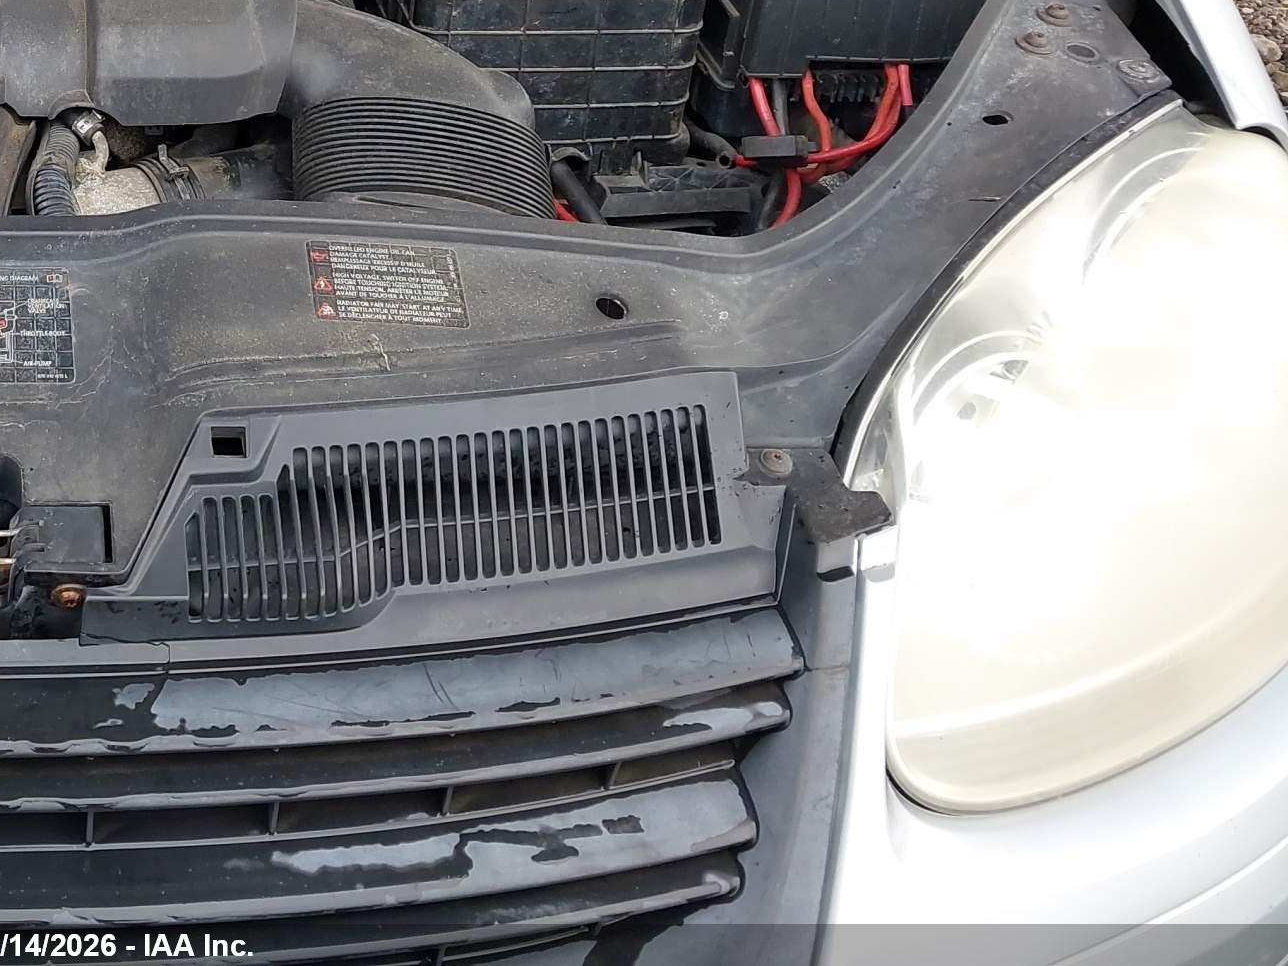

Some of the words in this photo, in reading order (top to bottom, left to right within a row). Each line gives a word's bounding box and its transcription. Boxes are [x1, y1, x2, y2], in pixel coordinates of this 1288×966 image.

[329, 245, 364, 253] OVERFILLED
[336, 299, 369, 307] RADIATOR
[346, 306, 388, 314] VENTILATEUR
